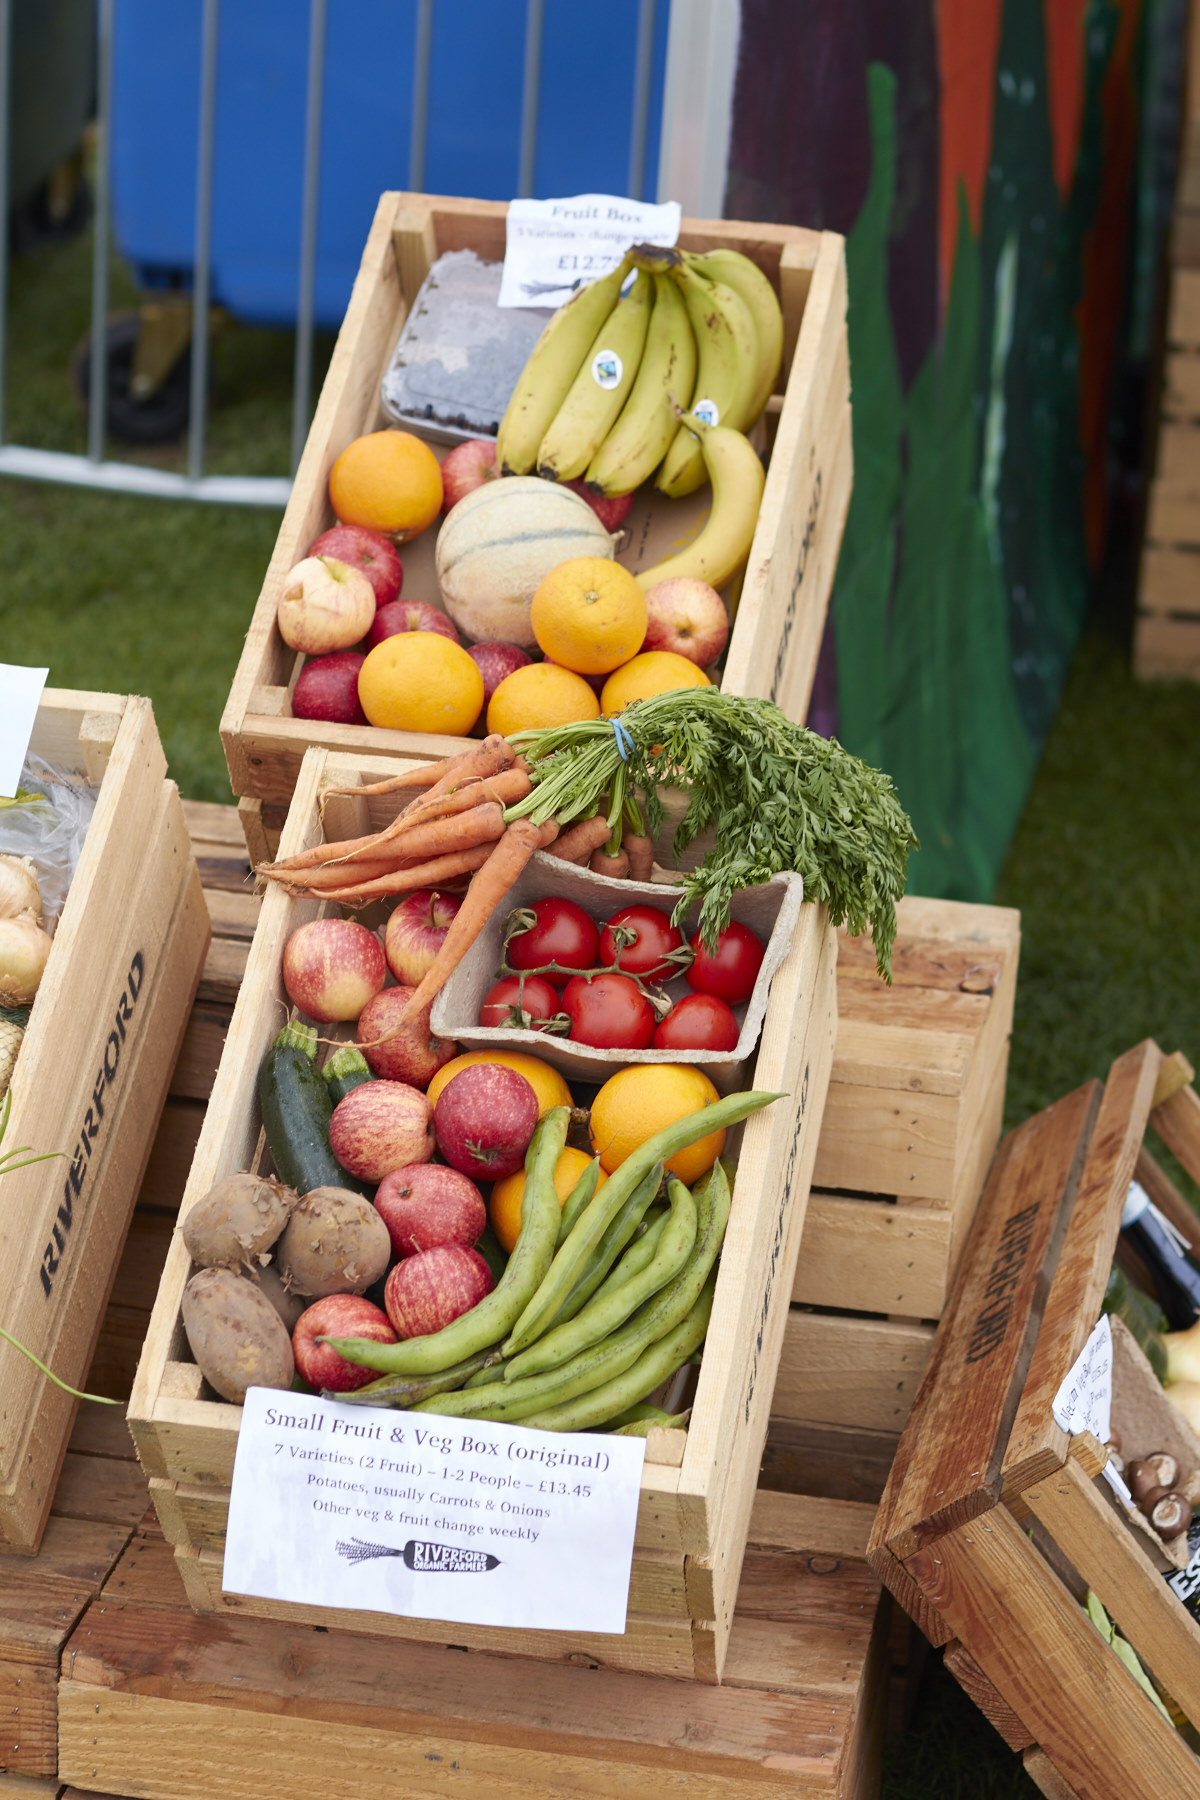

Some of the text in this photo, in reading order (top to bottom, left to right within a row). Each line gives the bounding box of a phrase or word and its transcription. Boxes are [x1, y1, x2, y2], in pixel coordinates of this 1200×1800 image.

[551, 205, 643, 223] Fruit Box
[40, 949, 145, 1299] RIVERFORD
[745, 1060, 810, 1427] RIVERFORD
[264, 1408, 610, 1472] Small Fruit & Veg Box (original)
[274, 1443, 284, 1456] 7
[289, 1445, 354, 1465] Varieties
[359, 1455, 374, 1469] (2
[379, 1458, 423, 1477] Fruit)
[442, 1467, 464, 1482] 1-2
[469, 1470, 521, 1490] People
[538, 1480, 592, 1497] £13.45
[307, 1473, 551, 1518] Potatoes, usually Carrots & Onions
[312, 1499, 540, 1542] Other veg & fruit change weekly
[413, 1541, 488, 1563] RIVERFORD
[413, 1560, 488, 1572] ORGANIC FARMERS
